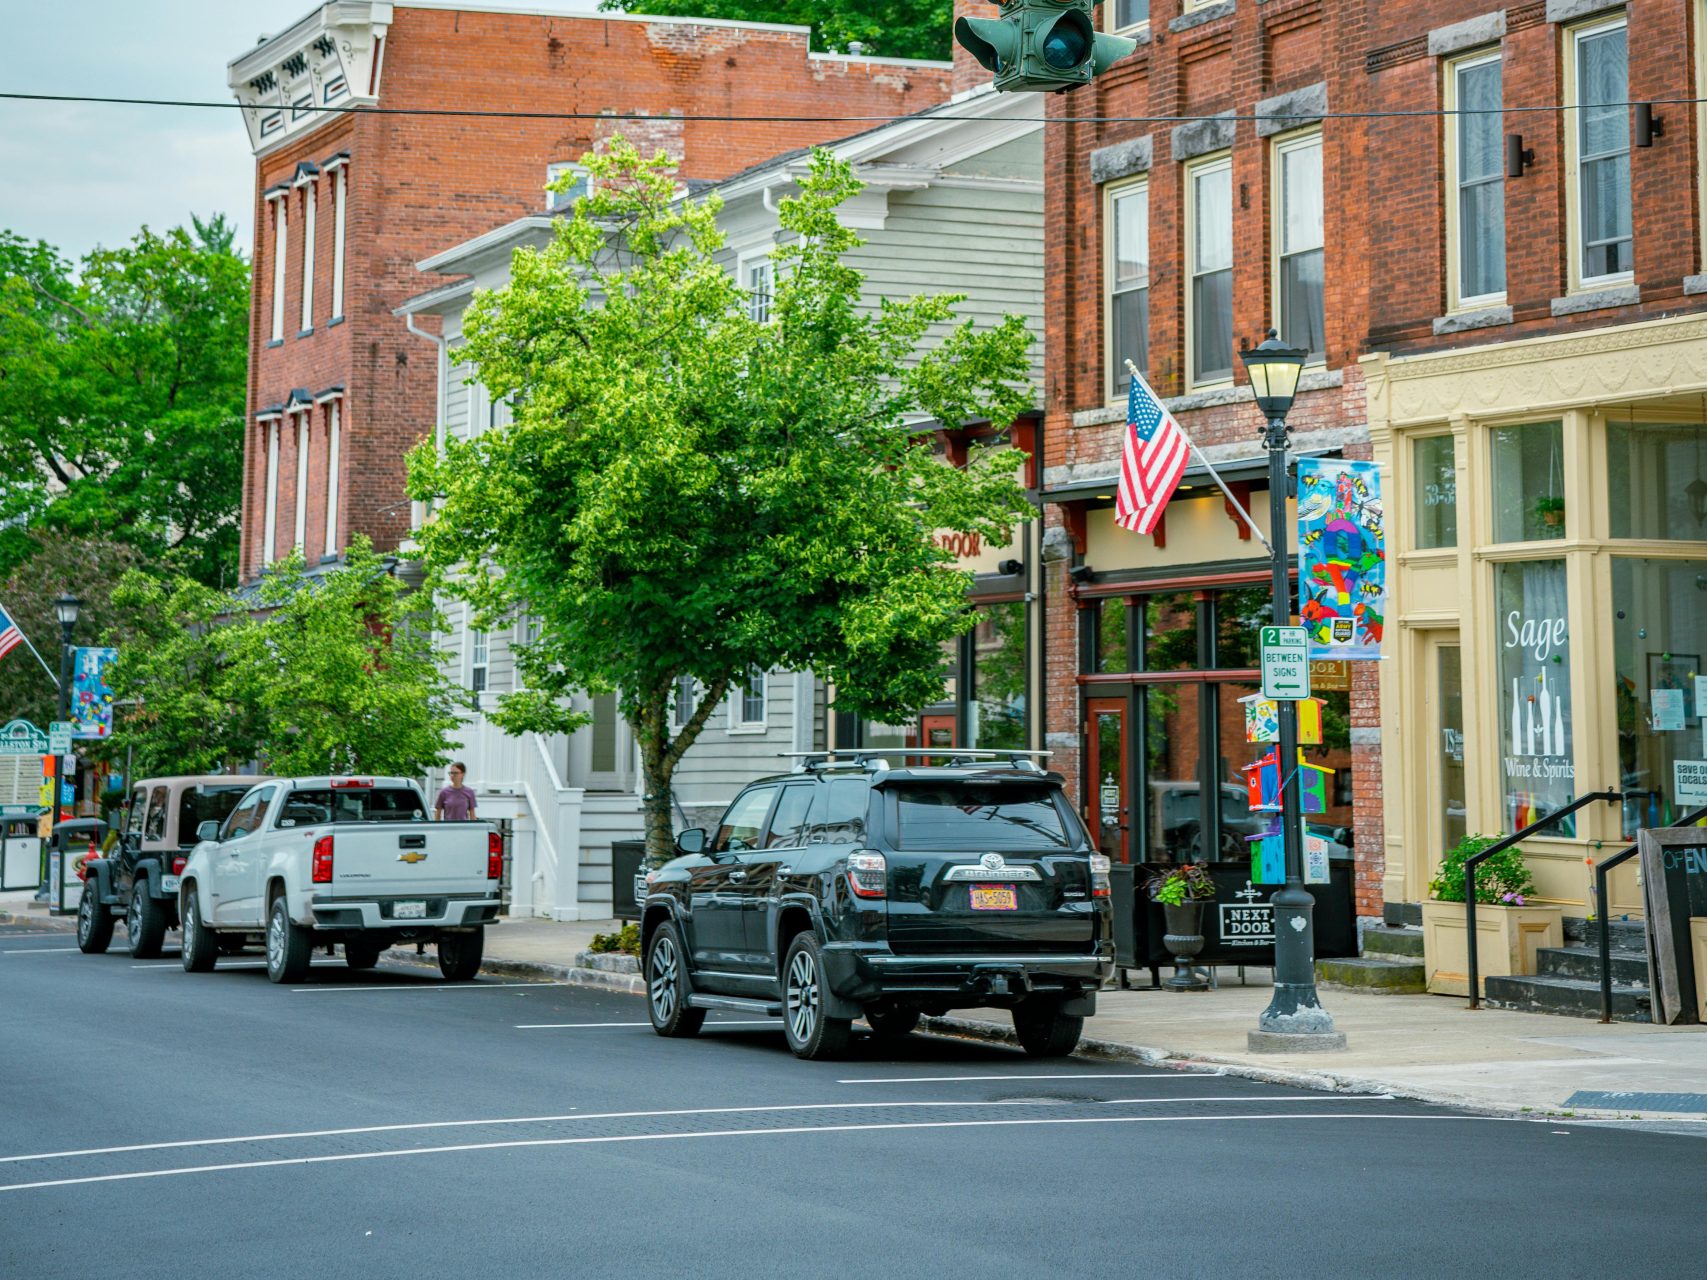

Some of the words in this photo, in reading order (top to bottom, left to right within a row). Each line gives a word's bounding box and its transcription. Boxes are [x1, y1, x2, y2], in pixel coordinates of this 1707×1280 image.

[1267, 629, 1276, 644] 2
[1505, 610, 1567, 661] Sage
[1266, 653, 1303, 662] BETWEEN
[1273, 667, 1297, 677] SIGNS
[1504, 757, 1531, 778] Wine
[1532, 757, 1542, 778] &
[1543, 757, 1575, 785] Spirits
[1231, 909, 1270, 921] NEXT
[1231, 922, 1271, 934] DOOR
